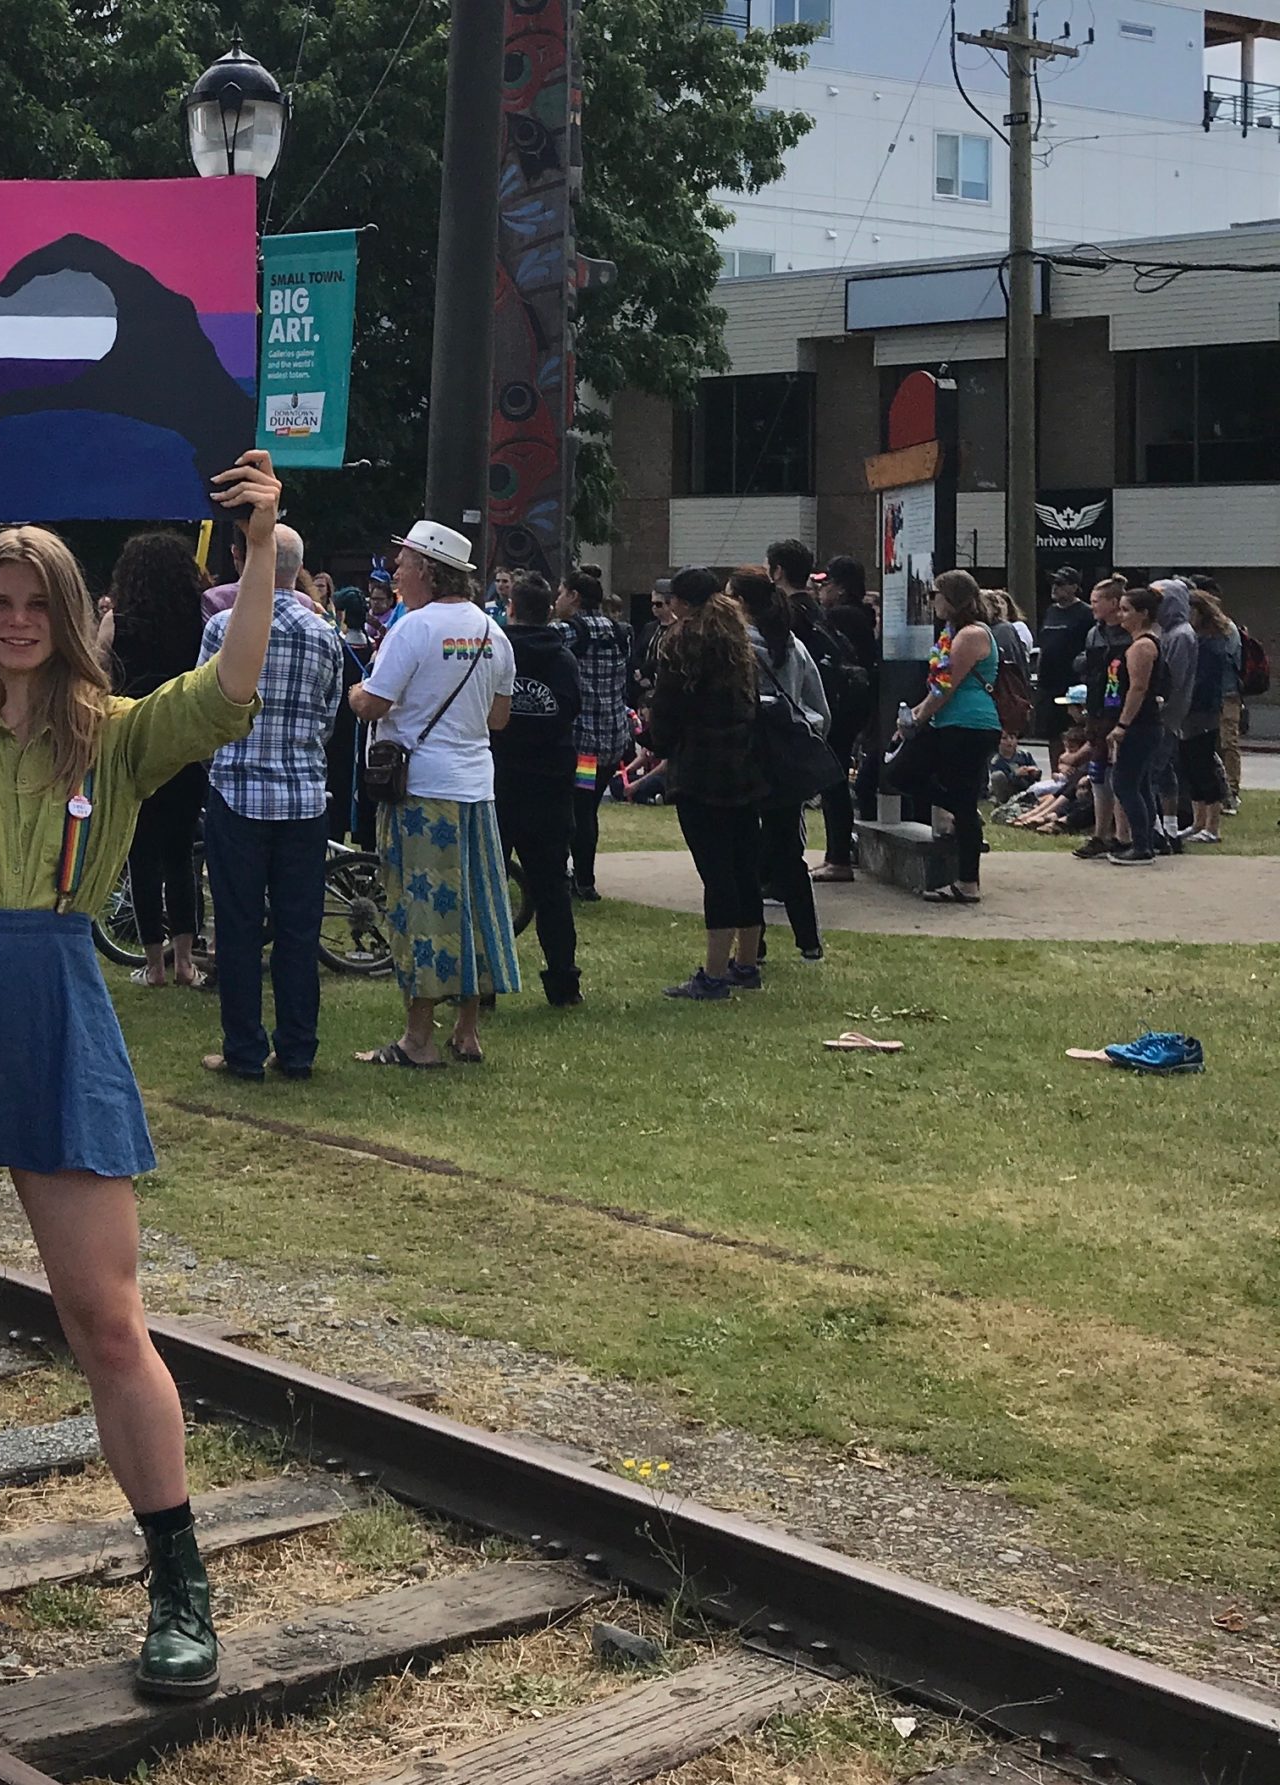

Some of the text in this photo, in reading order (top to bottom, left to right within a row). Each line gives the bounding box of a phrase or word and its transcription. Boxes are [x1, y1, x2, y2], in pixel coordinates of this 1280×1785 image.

[270, 270, 346, 286] SMALL TOWN.
[269, 287, 310, 315] BIG
[268, 316, 320, 344] ART.
[270, 416, 318, 427] DUNCAN
[1036, 534, 1107, 550] hrive valley
